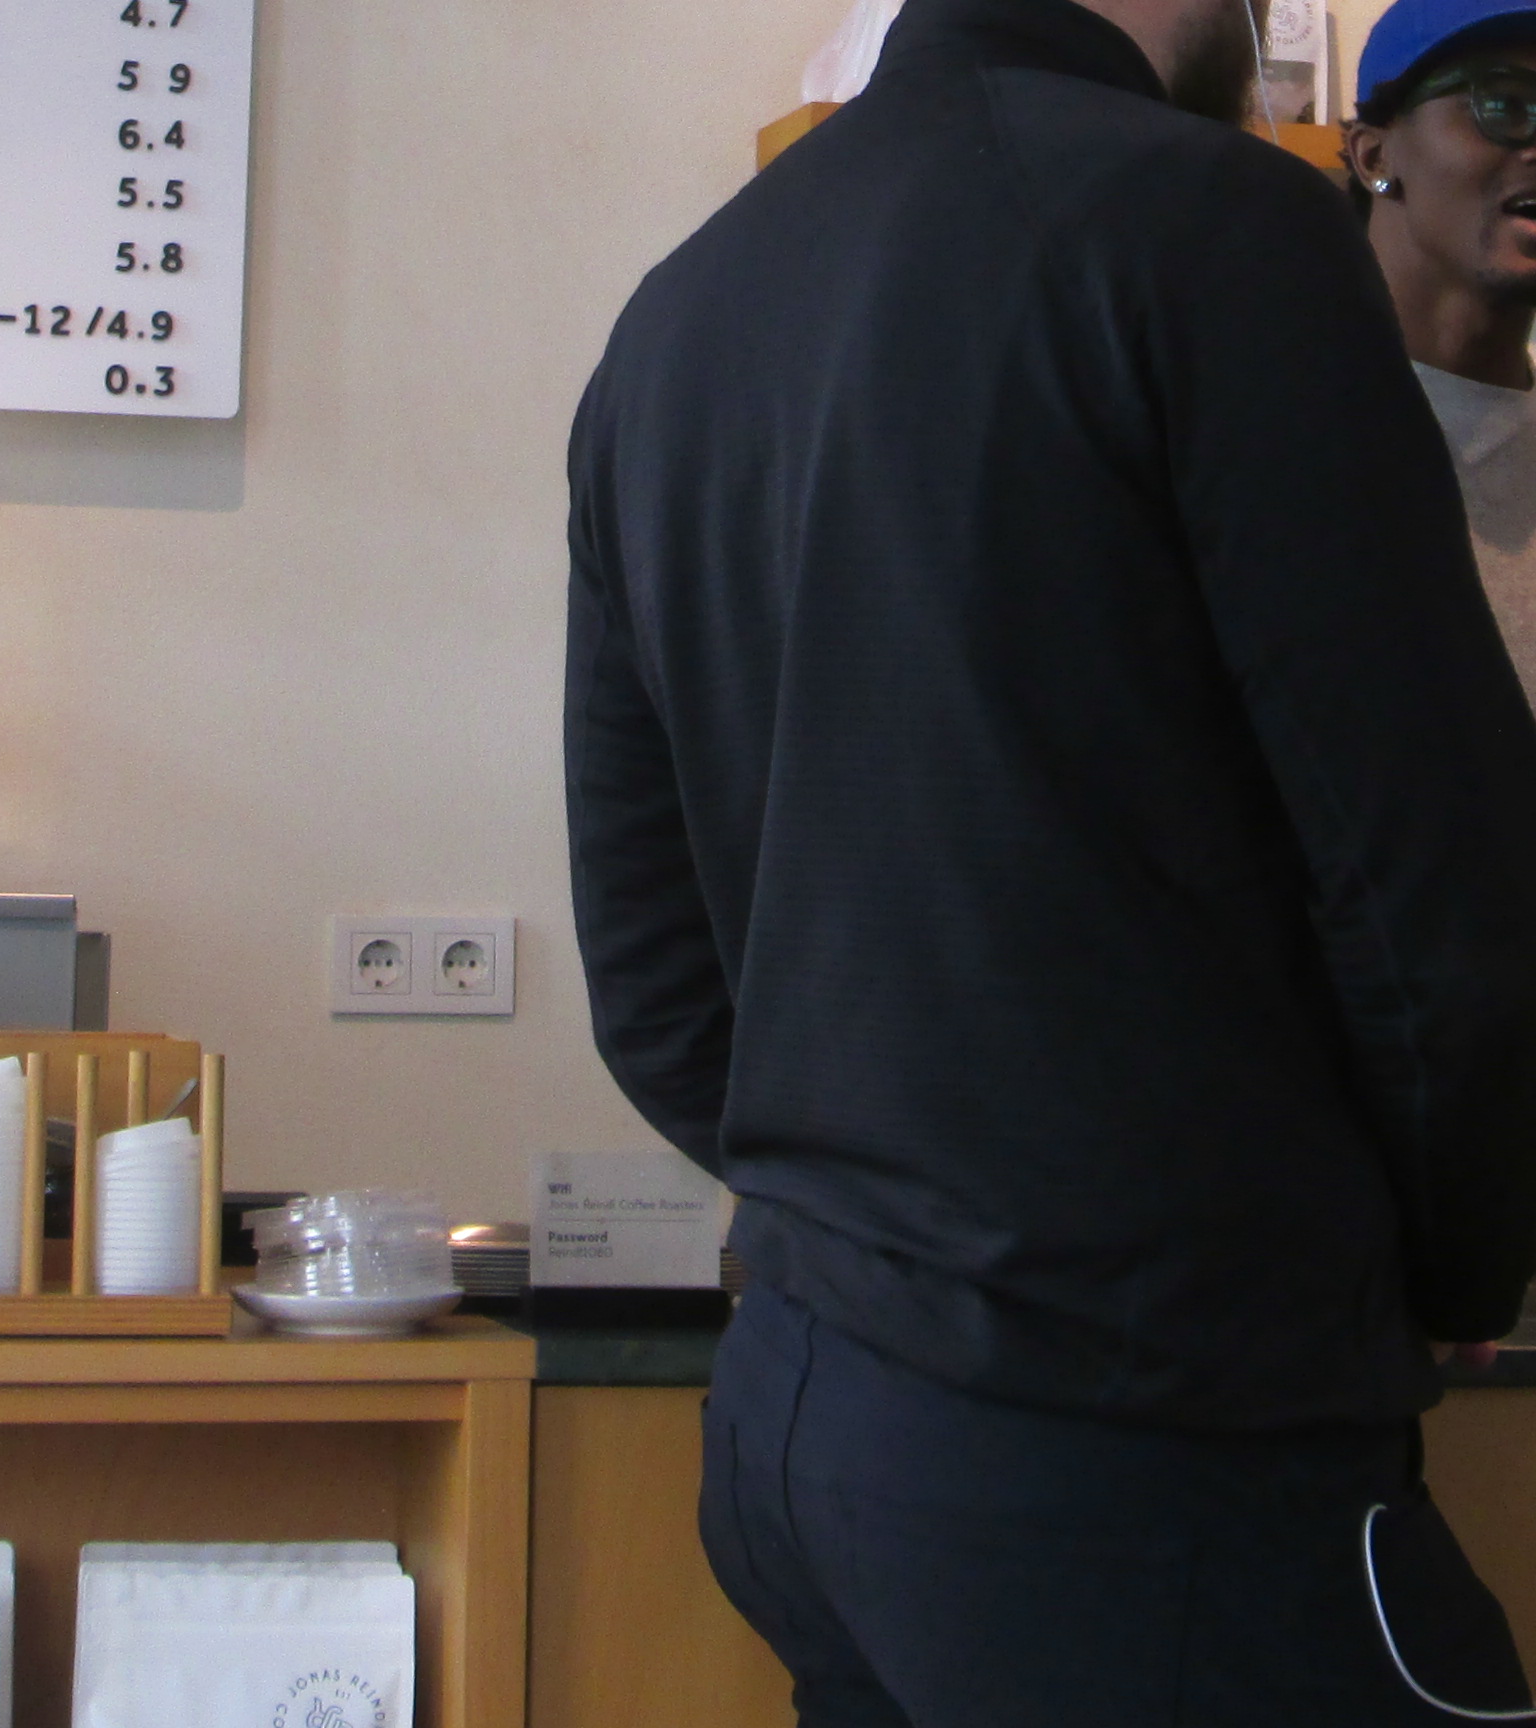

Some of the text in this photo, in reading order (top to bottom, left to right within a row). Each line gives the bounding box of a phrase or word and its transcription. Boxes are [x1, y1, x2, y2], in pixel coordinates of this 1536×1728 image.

[118, 118, 186, 151] 6.4
[117, 176, 184, 211] 5.5
[115, 241, 184, 275] 5.8
[104, 364, 176, 397] 0.3
[548, 1230, 609, 1243] Password
[288, 1669, 341, 1698] JONAS
